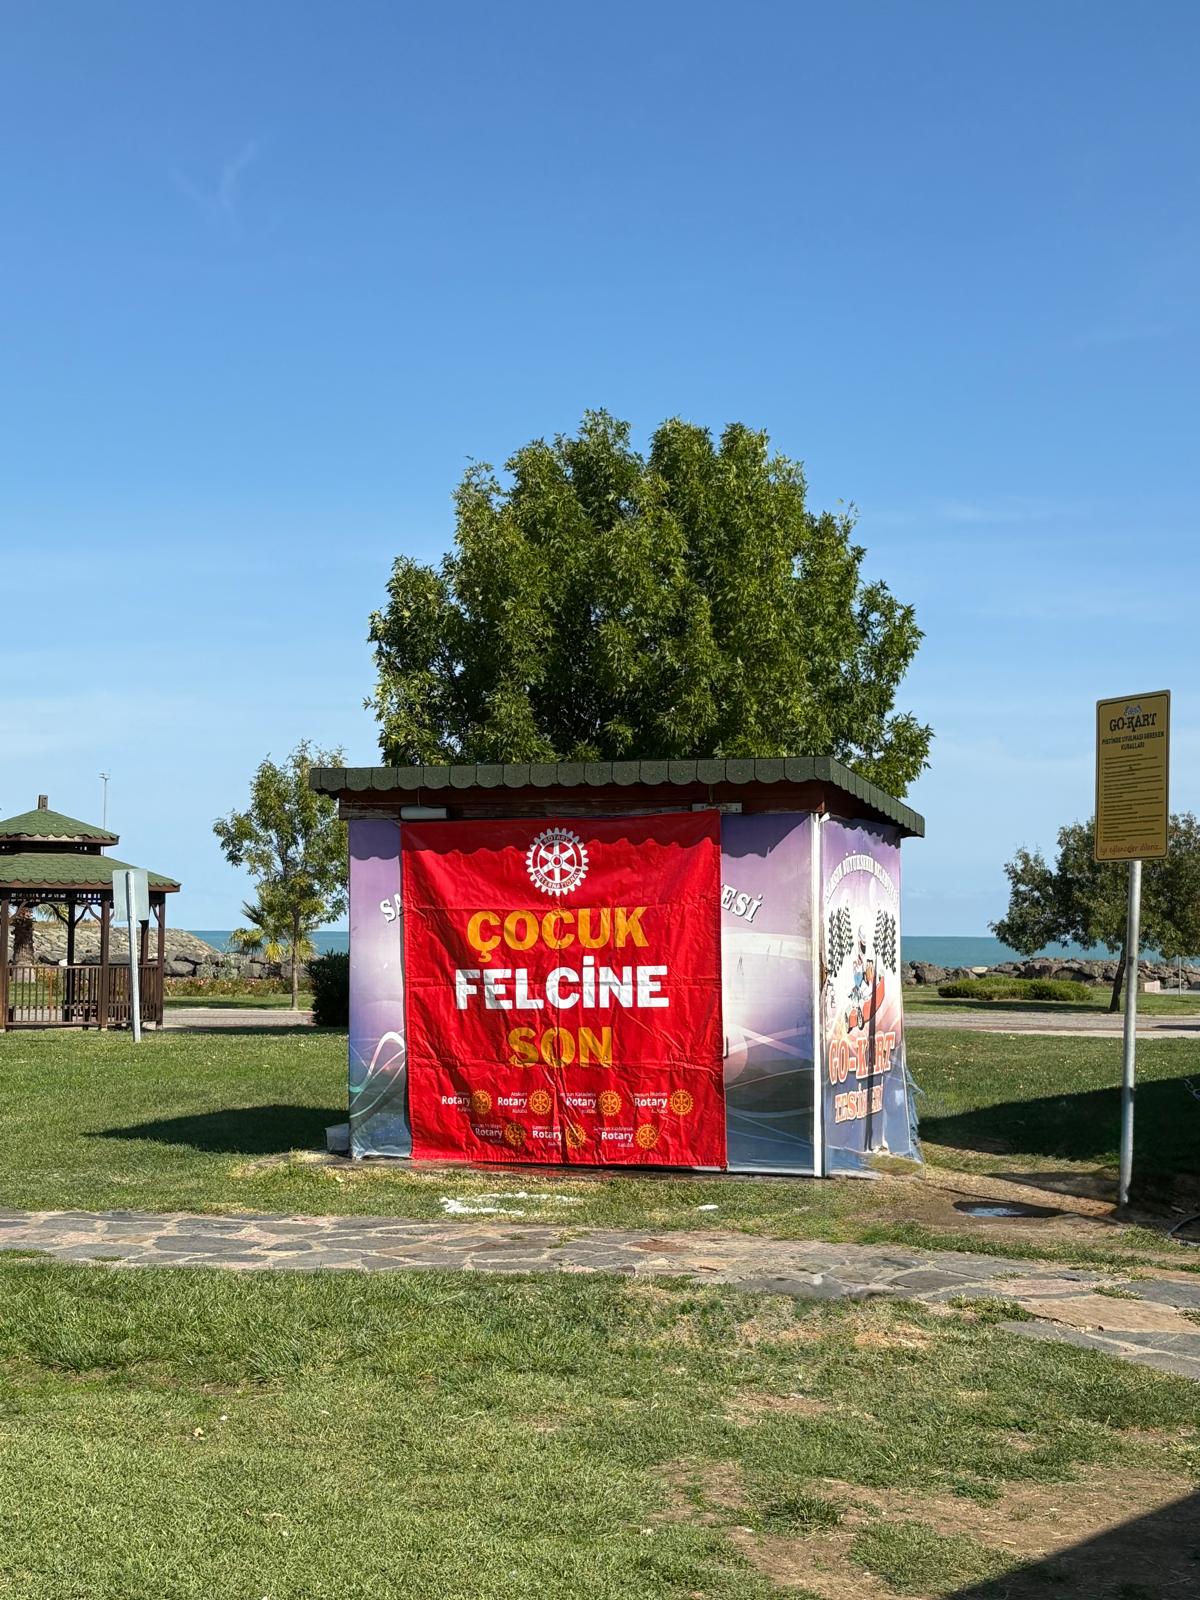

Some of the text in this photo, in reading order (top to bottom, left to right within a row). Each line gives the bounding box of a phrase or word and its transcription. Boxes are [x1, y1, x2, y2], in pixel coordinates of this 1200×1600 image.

[1109, 713, 1157, 732] GO-KART
[544, 834, 569, 844] ROTARY
[534, 869, 581, 890] INTERNATIONAL
[721, 883, 763, 923] ESİ
[467, 906, 649, 963] ÇOCUK
[455, 955, 670, 1010] FELCİNE
[507, 1026, 613, 1068] SON
[829, 1032, 896, 1085] GO-KART
[441, 1096, 470, 1107] Rotary
[497, 1097, 528, 1109] Rotary
[566, 1097, 597, 1109] Rotary
[634, 1097, 668, 1109] Rotary
[474, 1127, 503, 1139] Rotary
[532, 1130, 562, 1141] Rotary
[601, 1131, 634, 1143] Rotary
